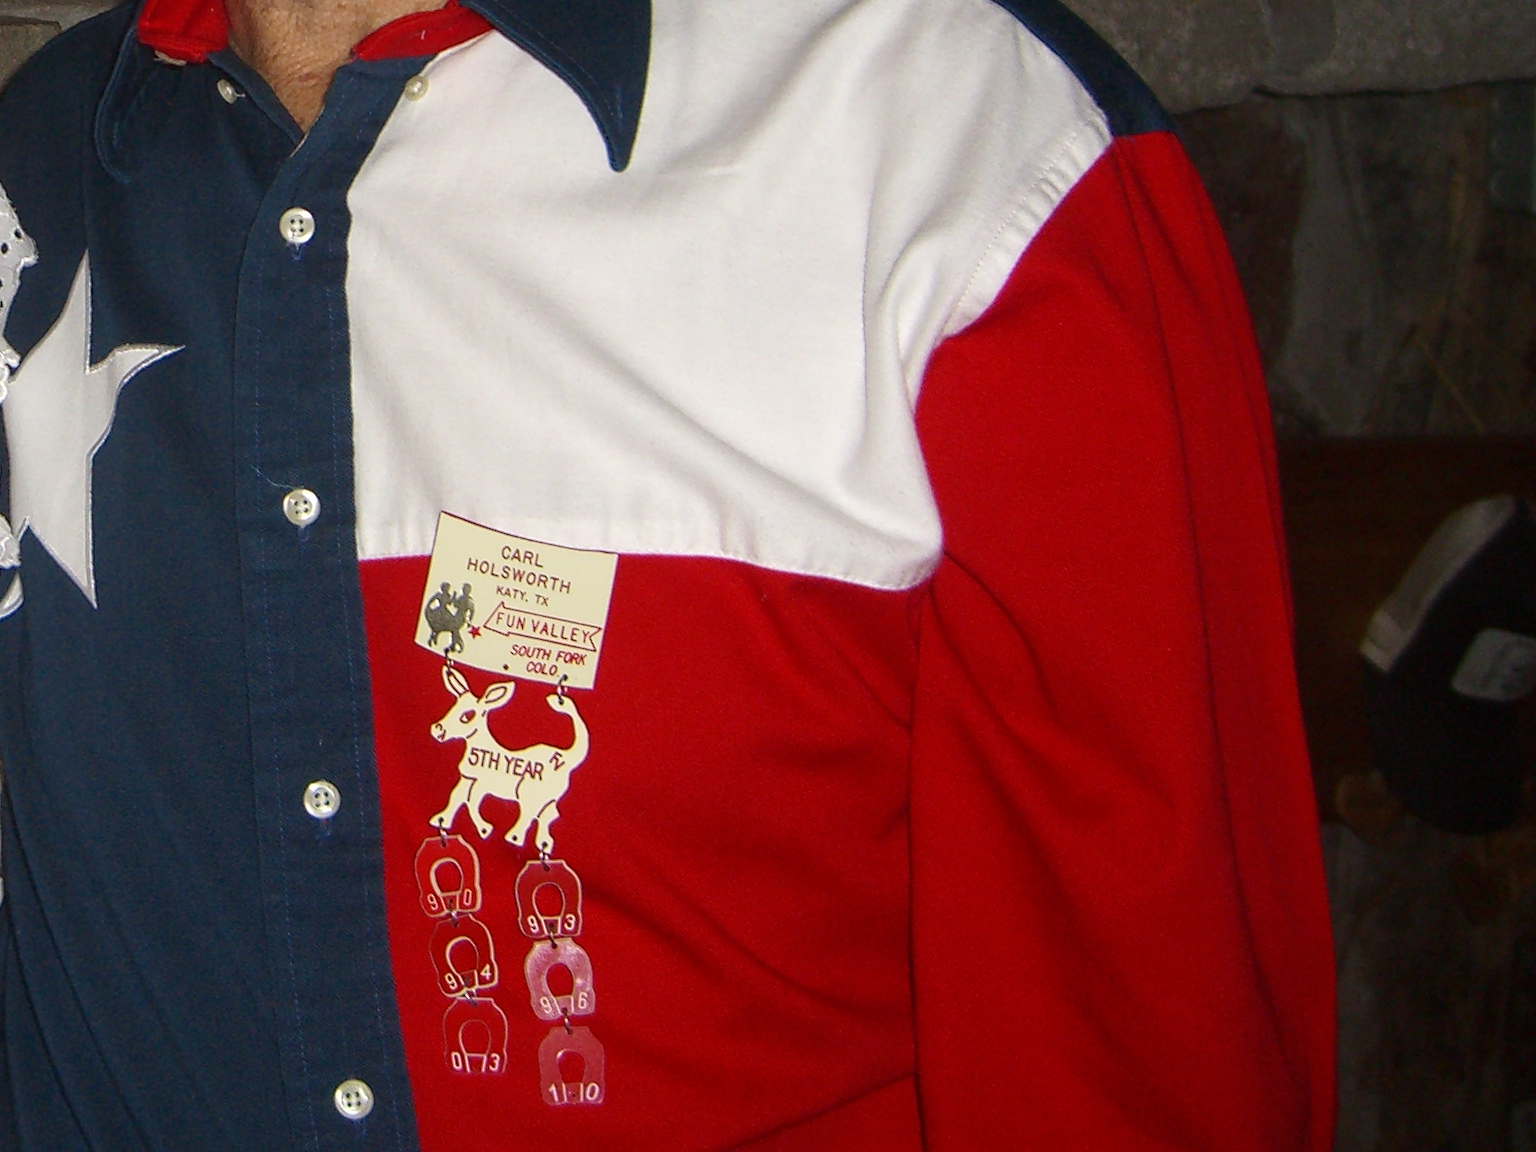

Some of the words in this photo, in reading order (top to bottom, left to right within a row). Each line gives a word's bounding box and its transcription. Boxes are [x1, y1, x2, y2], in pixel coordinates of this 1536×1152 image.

[501, 545, 544, 568] CARL
[466, 557, 572, 595] HOLSWORTH
[535, 594, 550, 607] TX
[496, 611, 526, 631] FUN
[531, 618, 591, 644] VALLEY
[510, 644, 552, 661] SOUTH
[555, 650, 588, 666] FORK
[468, 747, 500, 771] 5TH
[504, 755, 544, 781] YEAR
